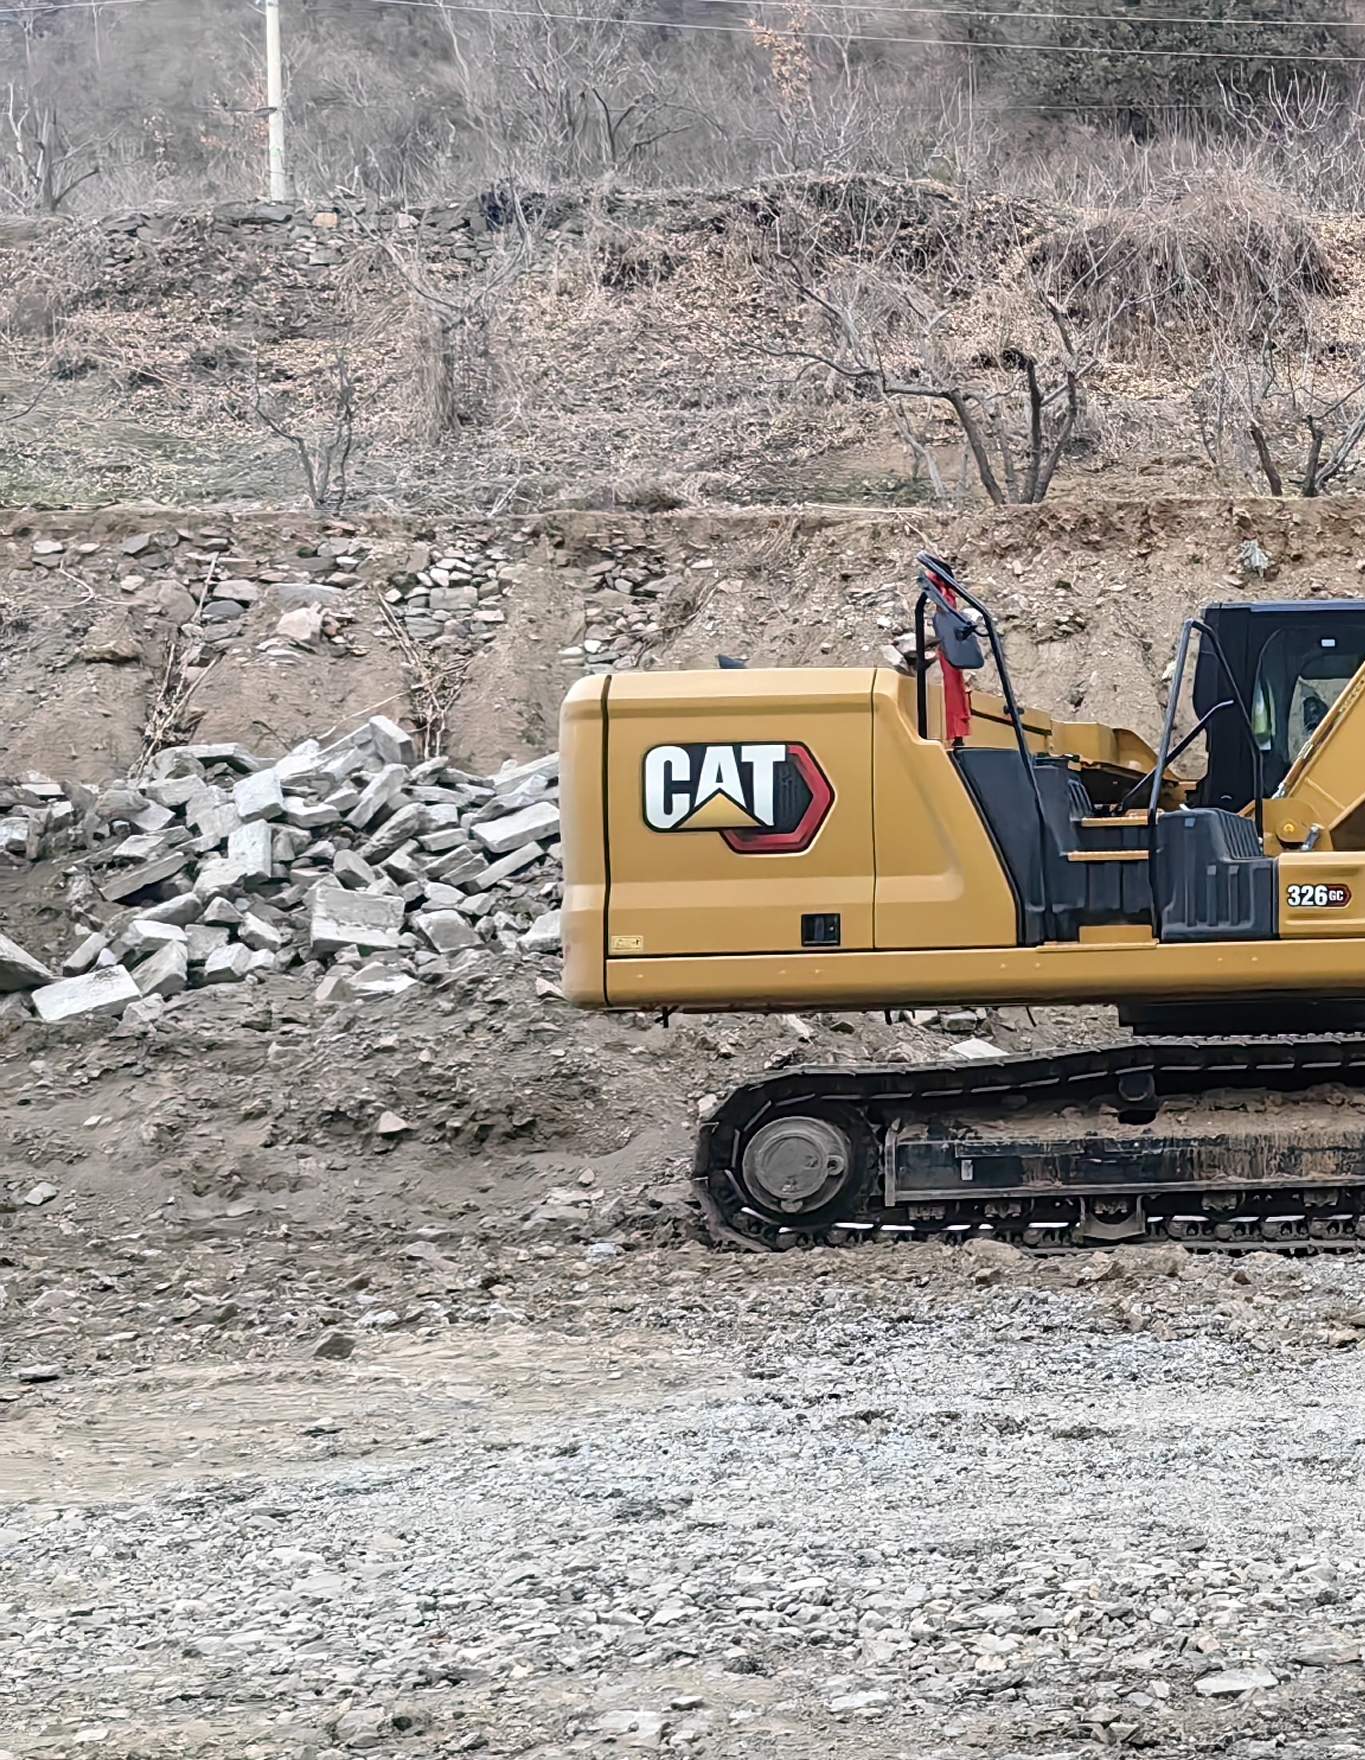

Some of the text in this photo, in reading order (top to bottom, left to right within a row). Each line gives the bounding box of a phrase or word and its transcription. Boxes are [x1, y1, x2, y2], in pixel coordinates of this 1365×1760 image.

[645, 744, 787, 829] CAT
[1287, 884, 1344, 906] 326 GC
